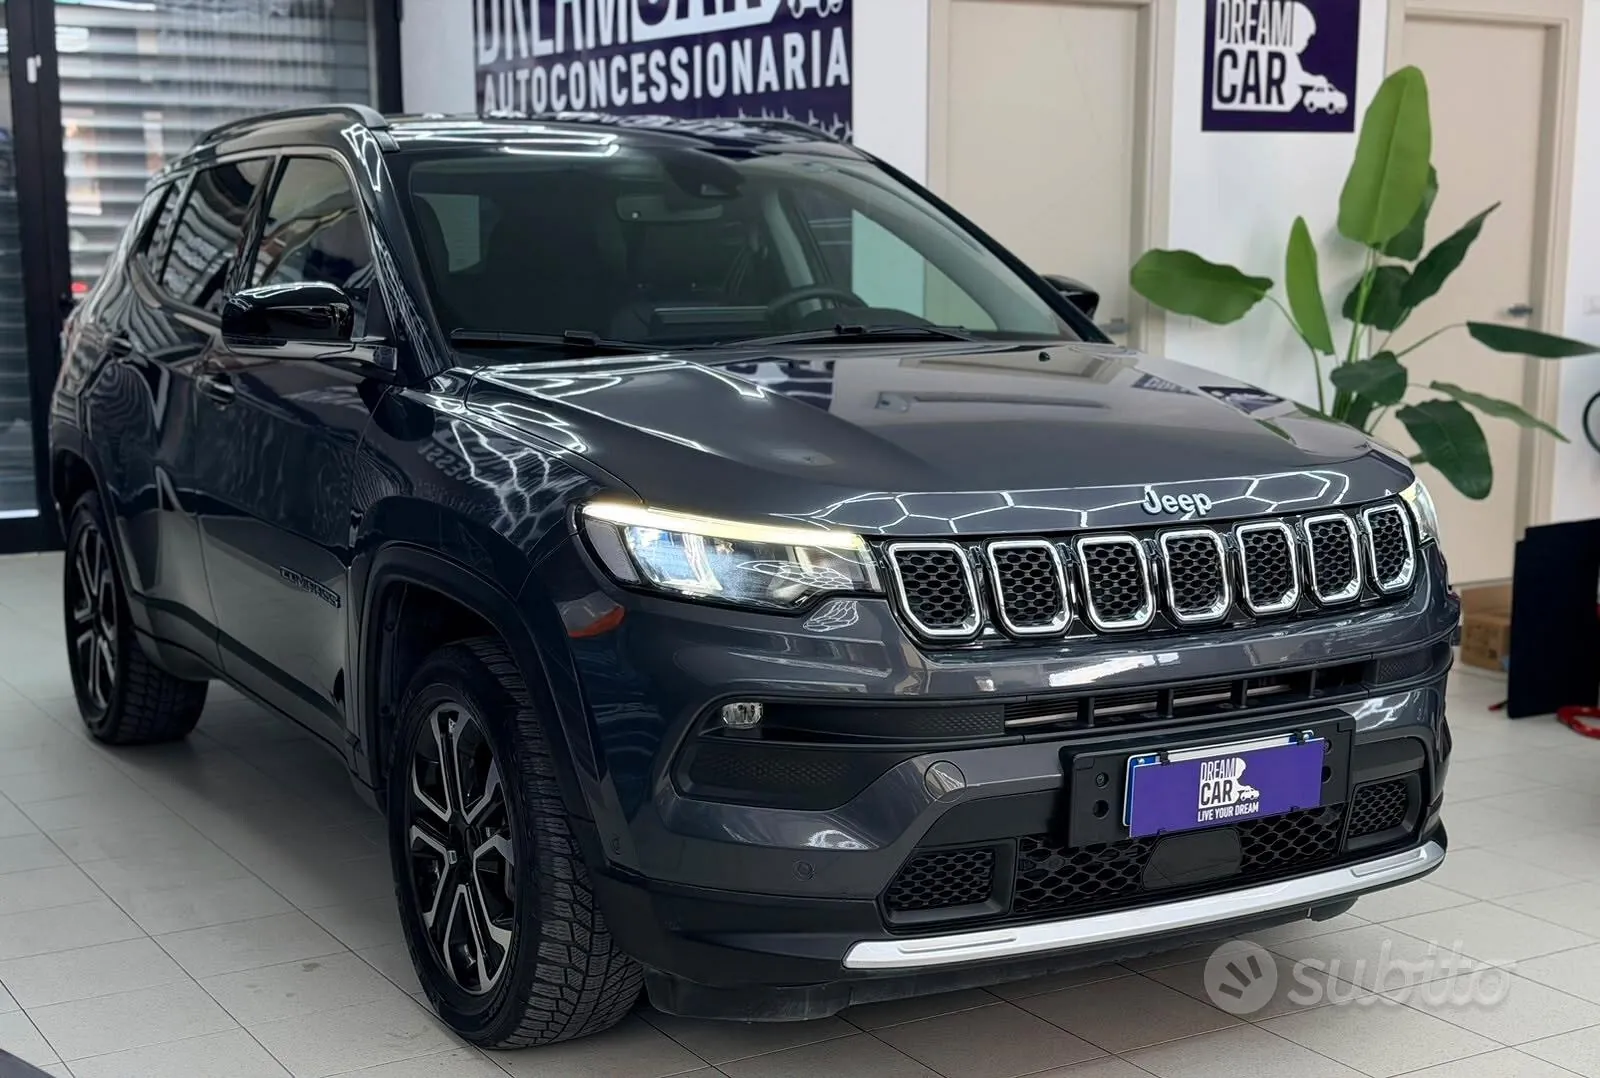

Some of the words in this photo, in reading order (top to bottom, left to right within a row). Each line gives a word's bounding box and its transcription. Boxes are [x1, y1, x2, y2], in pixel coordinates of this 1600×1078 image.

[1215, 0, 1294, 46] DREAM
[484, 27, 850, 115] AUTOCONCESSIONARIA
[1217, 48, 1286, 105] CAR
[1142, 489, 1212, 516] Jeep
[1200, 757, 1236, 781] DREAM
[1201, 780, 1232, 805] CAR
[1197, 809, 1213, 822] LIVE
[1215, 806, 1234, 819] YOUR
[1235, 801, 1259, 816] DREAM
